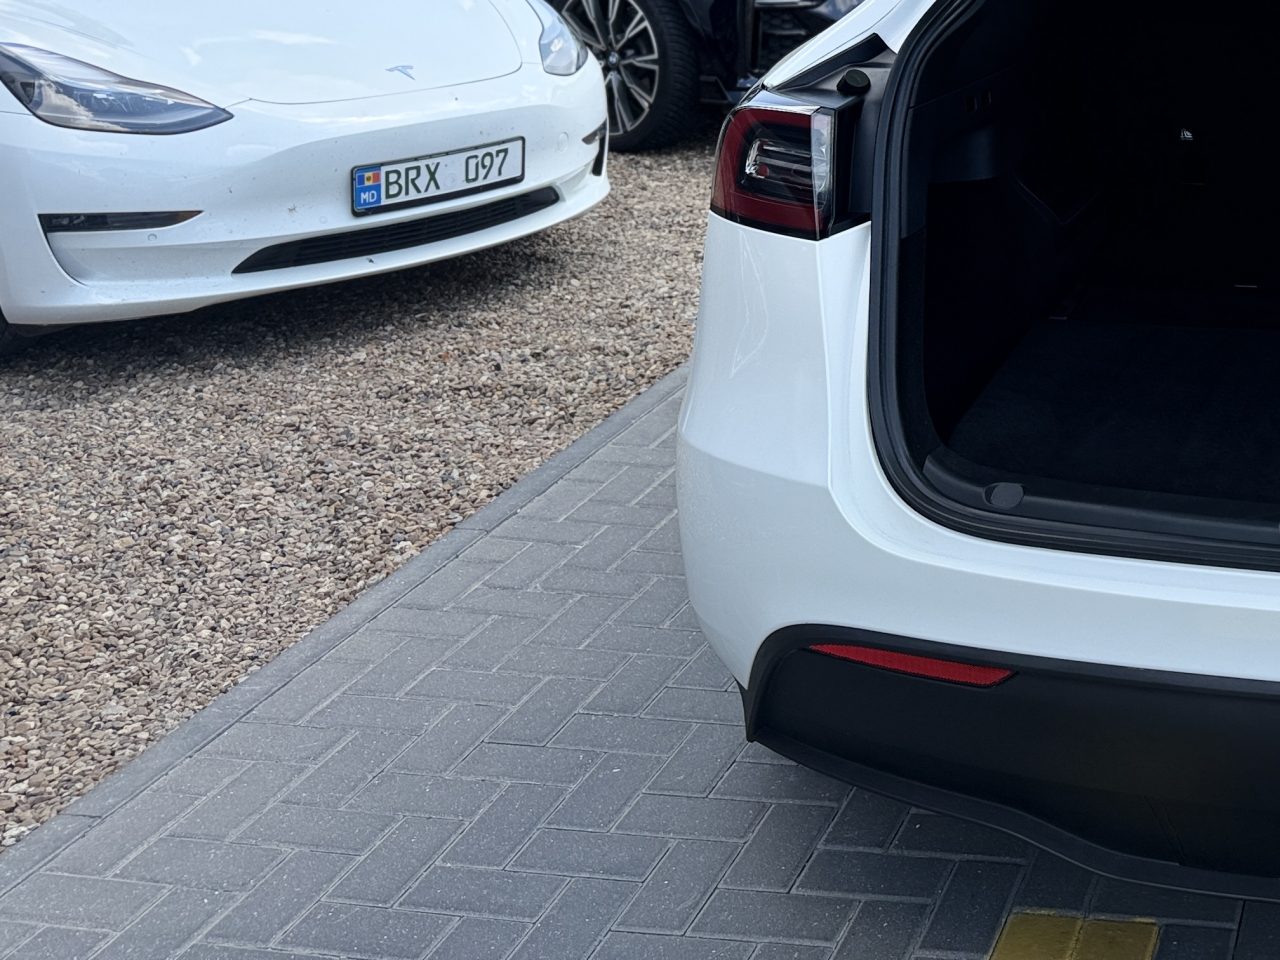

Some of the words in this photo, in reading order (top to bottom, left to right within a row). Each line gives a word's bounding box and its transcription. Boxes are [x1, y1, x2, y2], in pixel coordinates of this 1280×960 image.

[360, 190, 377, 204] MD
[384, 162, 440, 200] BRX
[465, 147, 508, 184] 097
